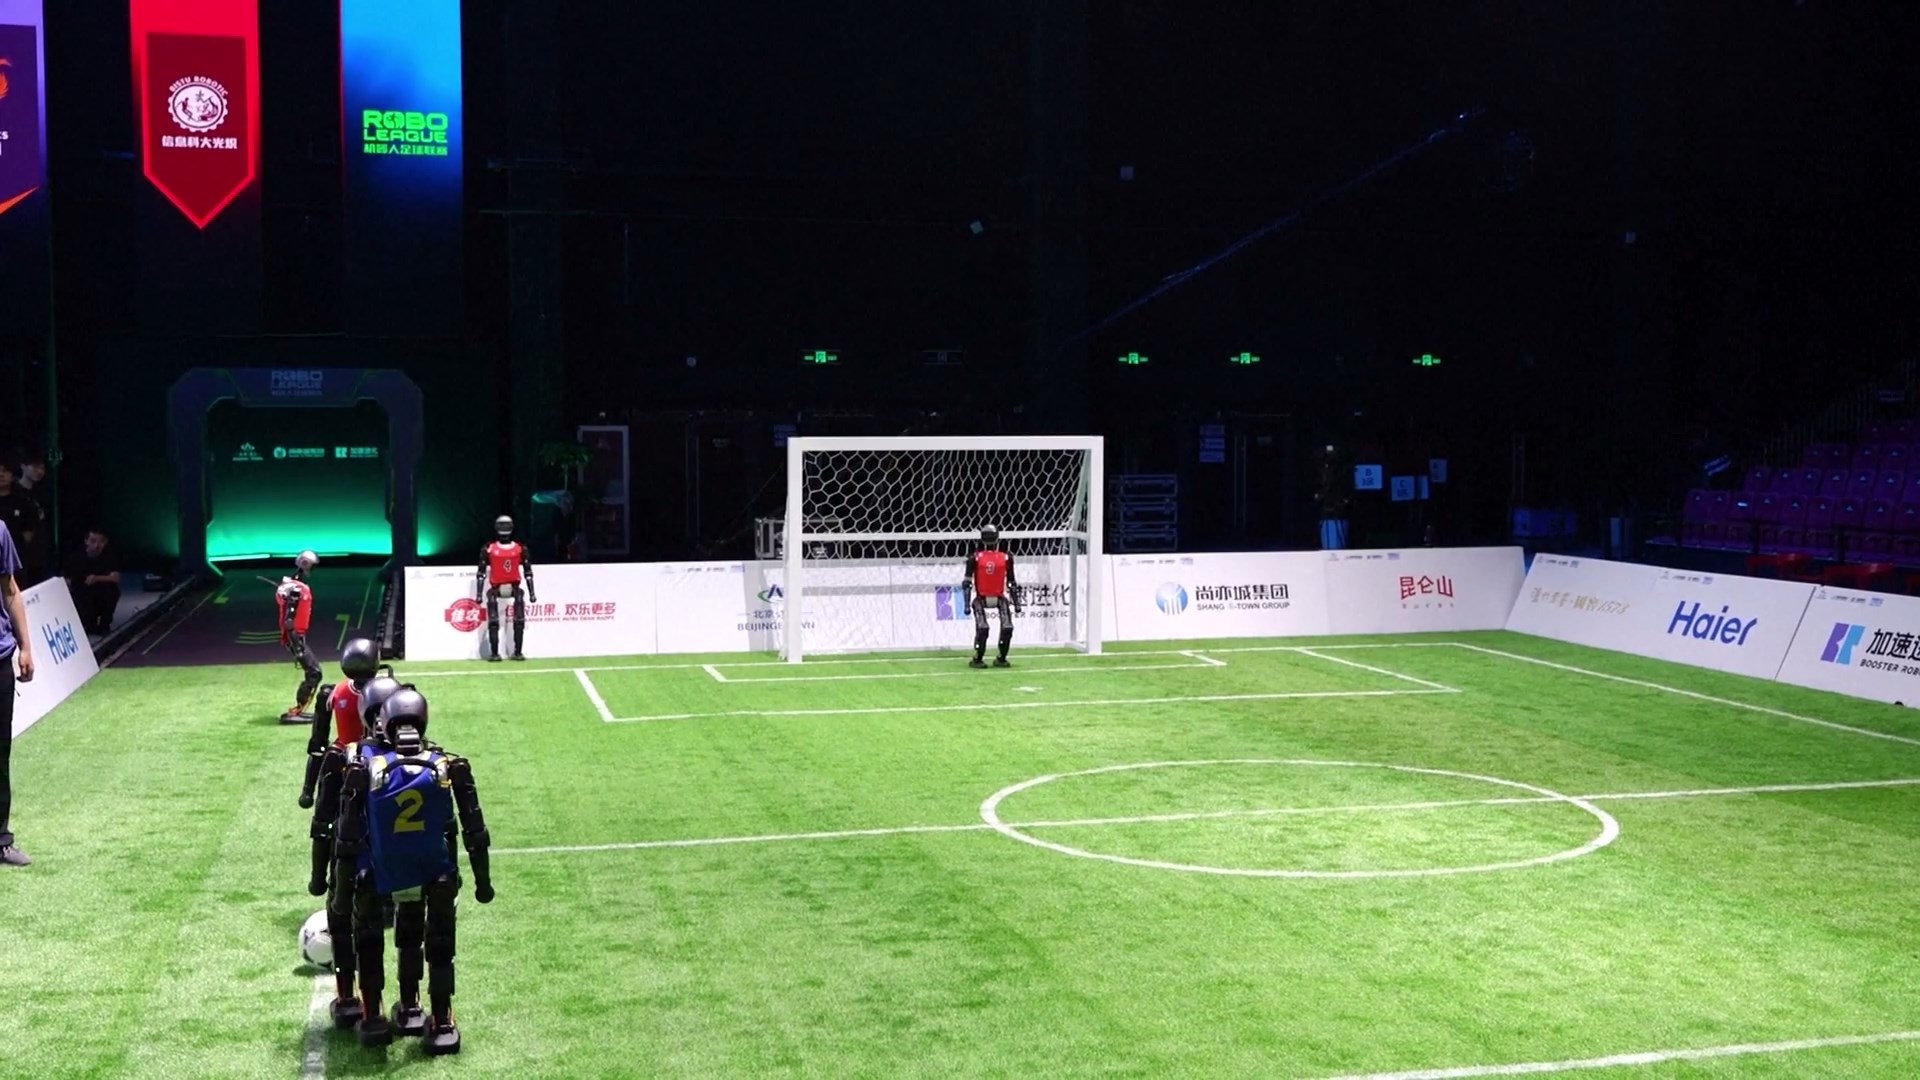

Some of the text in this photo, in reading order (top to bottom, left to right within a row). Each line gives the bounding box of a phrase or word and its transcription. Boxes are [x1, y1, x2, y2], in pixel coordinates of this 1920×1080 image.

[363, 110, 448, 129] ROBO
[363, 129, 448, 143] LEAGUE
[503, 560, 512, 573] 4
[1195, 583, 1289, 601] 尚亦城集团
[1400, 575, 1454, 600] 昆仑山
[1196, 603, 1225, 611] SHANG
[1261, 601, 1290, 609] GROUP
[1667, 600, 1758, 646] Haier
[41, 617, 79, 665] Haier
[1860, 659, 1920, 676] BOOSTER ROB
[393, 790, 425, 833] 2
